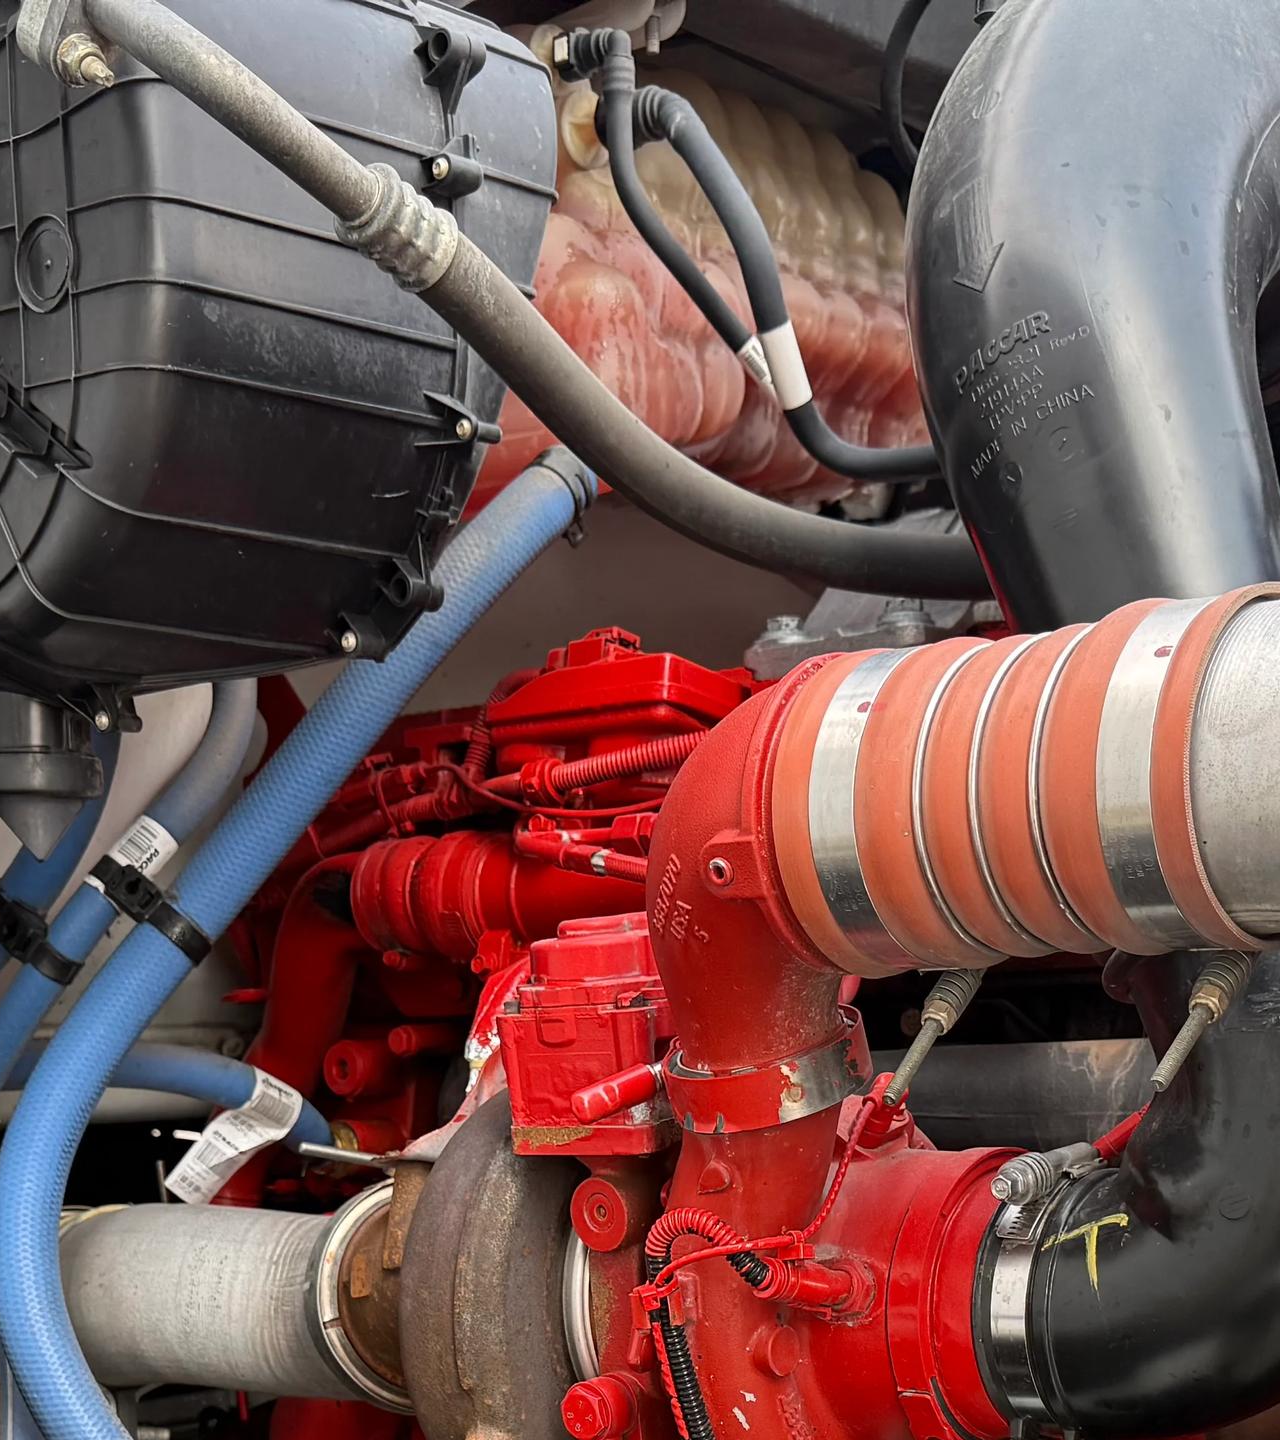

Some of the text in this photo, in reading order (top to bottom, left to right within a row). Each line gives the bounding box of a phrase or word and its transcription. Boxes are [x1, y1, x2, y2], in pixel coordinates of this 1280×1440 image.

[952, 310, 1052, 395] PACCAR
[1011, 416, 1027, 437] IN
[1035, 384, 1096, 421] CHINA
